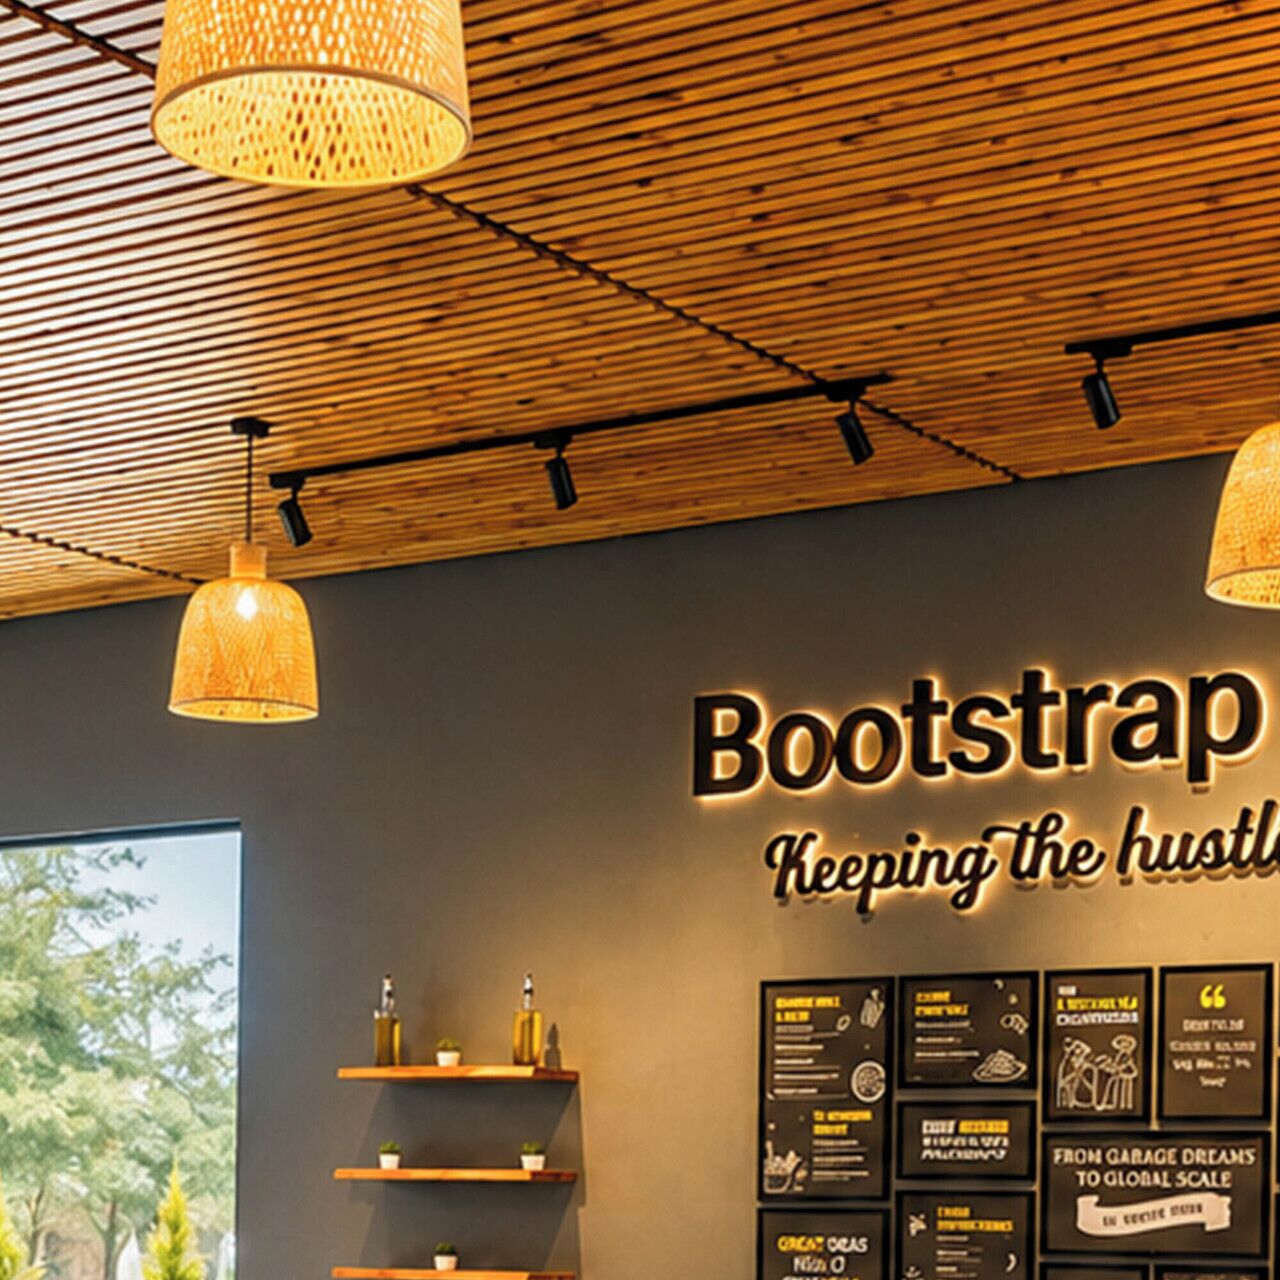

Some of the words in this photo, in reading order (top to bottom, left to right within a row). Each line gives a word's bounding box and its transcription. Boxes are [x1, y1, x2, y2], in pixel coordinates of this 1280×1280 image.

[693, 666, 1263, 797] Bootstrap
[764, 832, 997, 914] Keeping
[982, 812, 1106, 880] the
[1053, 1148, 1102, 1165] FROM
[1106, 1148, 1177, 1166] GARAGE
[1182, 1148, 1257, 1166] DREAMS
[1076, 1171, 1100, 1187] TO
[1104, 1171, 1171, 1188] GLOBAL
[1175, 1171, 1233, 1189] SCALE
